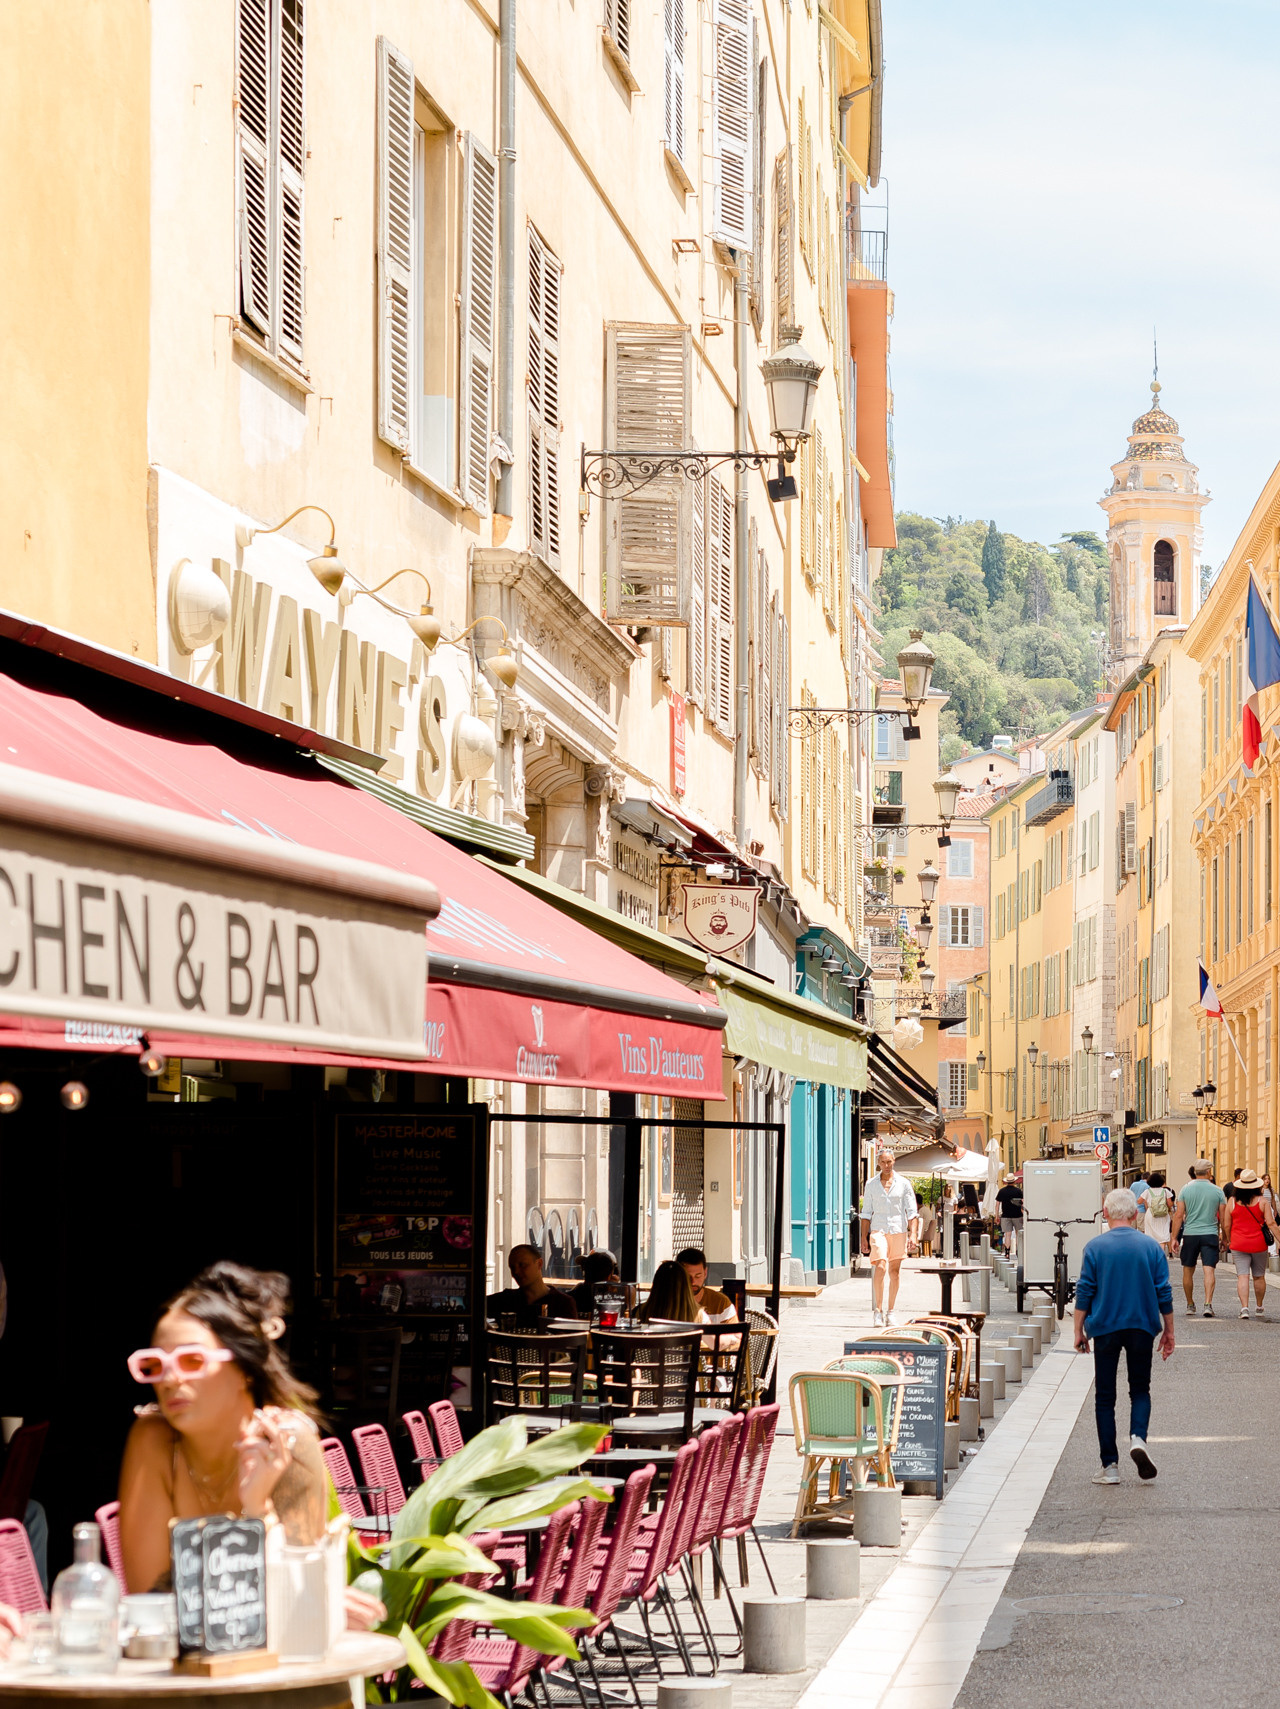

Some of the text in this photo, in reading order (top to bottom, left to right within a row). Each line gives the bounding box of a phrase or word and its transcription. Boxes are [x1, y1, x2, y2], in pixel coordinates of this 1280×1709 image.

[212, 558, 447, 798] WAYNE'S
[691, 892, 751, 913] King's Pub
[174, 901, 208, 1013] &
[227, 909, 322, 1027] BAR
[618, 1032, 705, 1081] Vins D'auteurs
[372, 1147, 442, 1160] Live Music
[369, 1251, 434, 1260] TOUS LES JEUDIS
